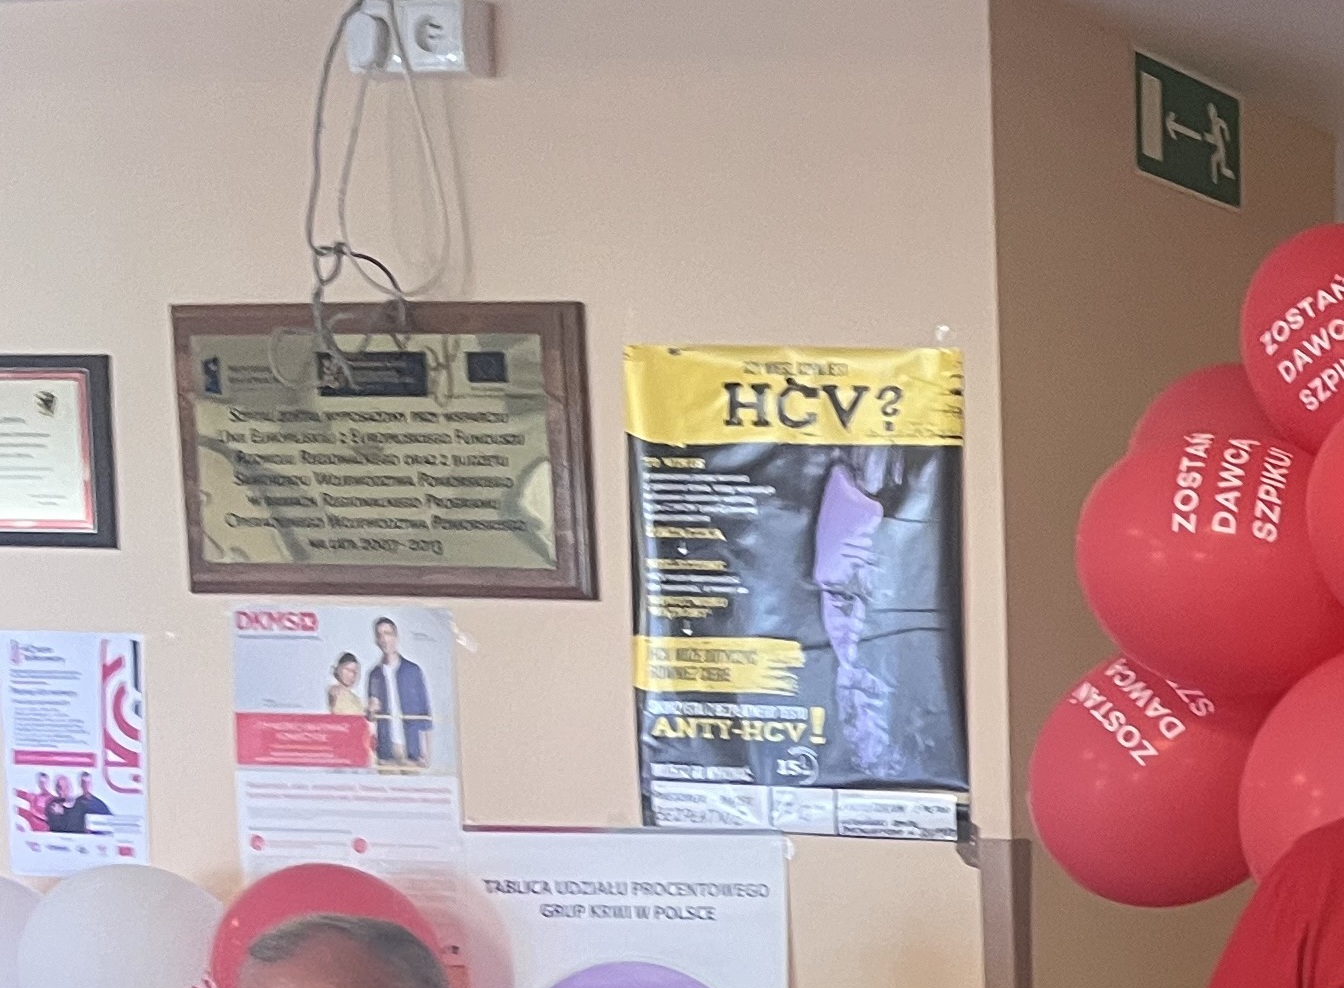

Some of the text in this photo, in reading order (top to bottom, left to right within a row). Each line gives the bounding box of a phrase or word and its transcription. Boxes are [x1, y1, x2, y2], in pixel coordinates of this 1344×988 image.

[1171, 433, 1215, 534] ZOSTAŃ
[482, 879, 553, 895] TABLICA
[631, 881, 770, 898] PROCENTOWEGO
[540, 904, 717, 921] GRUP KRWI W POLSCE
